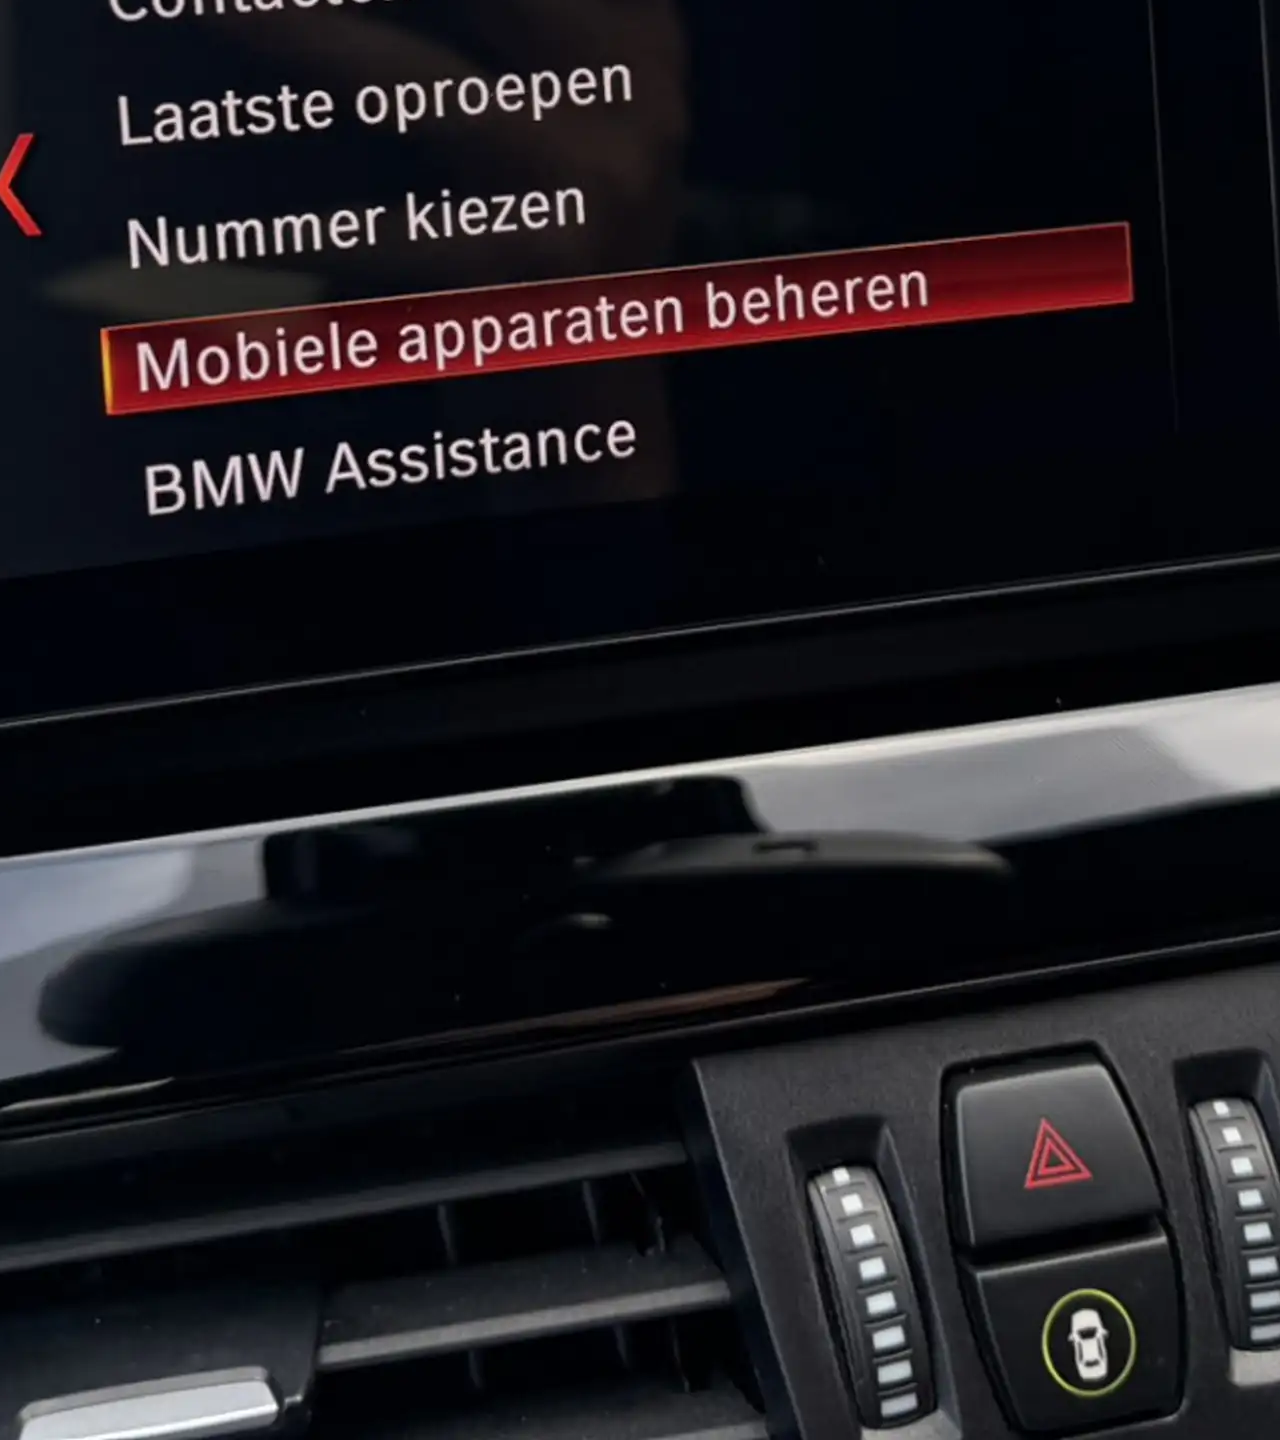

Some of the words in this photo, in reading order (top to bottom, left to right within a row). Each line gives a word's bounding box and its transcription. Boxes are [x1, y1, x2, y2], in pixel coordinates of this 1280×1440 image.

[117, 84, 334, 146] Laatste
[355, 63, 632, 134] oproepen
[126, 205, 386, 270] Nummer
[405, 186, 585, 241] kiezen
[136, 320, 378, 393] Mobiele
[396, 292, 684, 371] apparaten
[704, 266, 929, 330] beheren
[144, 446, 304, 516] BMW
[324, 419, 636, 494] Assistance
